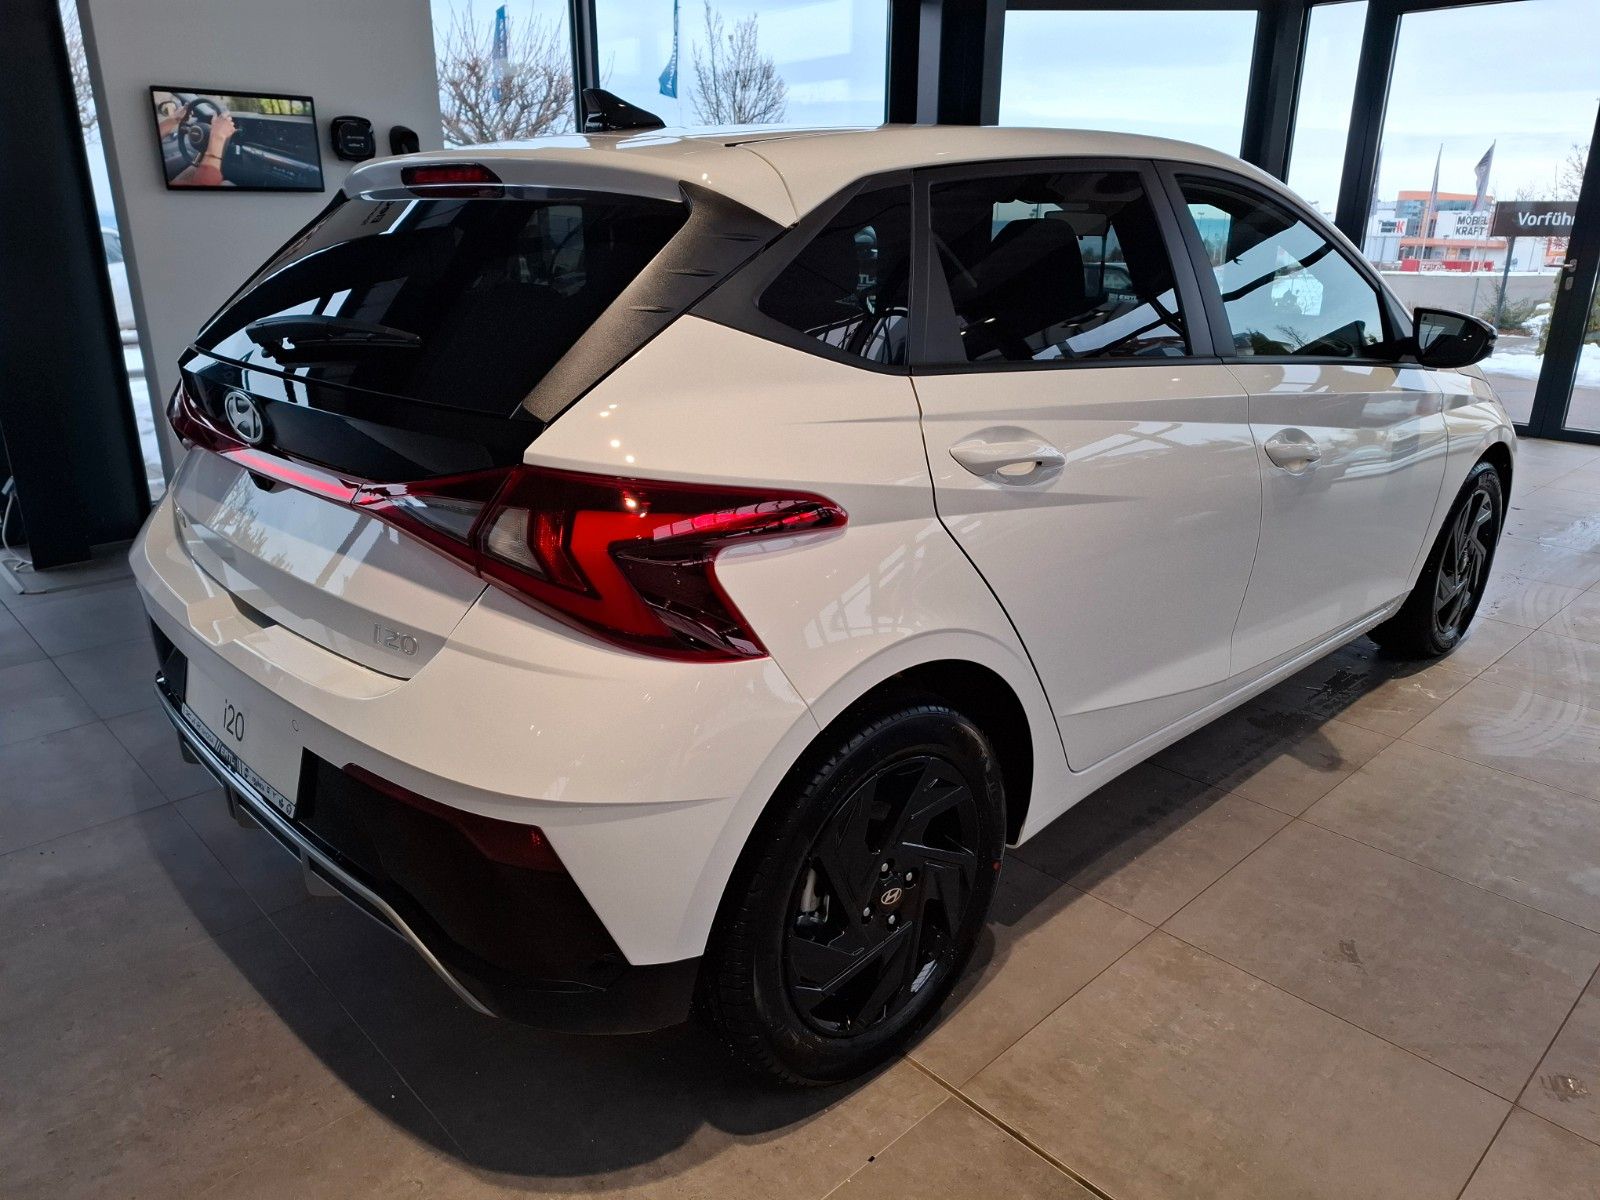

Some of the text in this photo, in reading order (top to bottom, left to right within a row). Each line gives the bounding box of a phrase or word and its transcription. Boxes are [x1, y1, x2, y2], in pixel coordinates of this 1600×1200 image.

[1457, 213, 1488, 226] MÖBEL
[1456, 226, 1485, 236] KRAFT
[223, 699, 245, 742] i20
